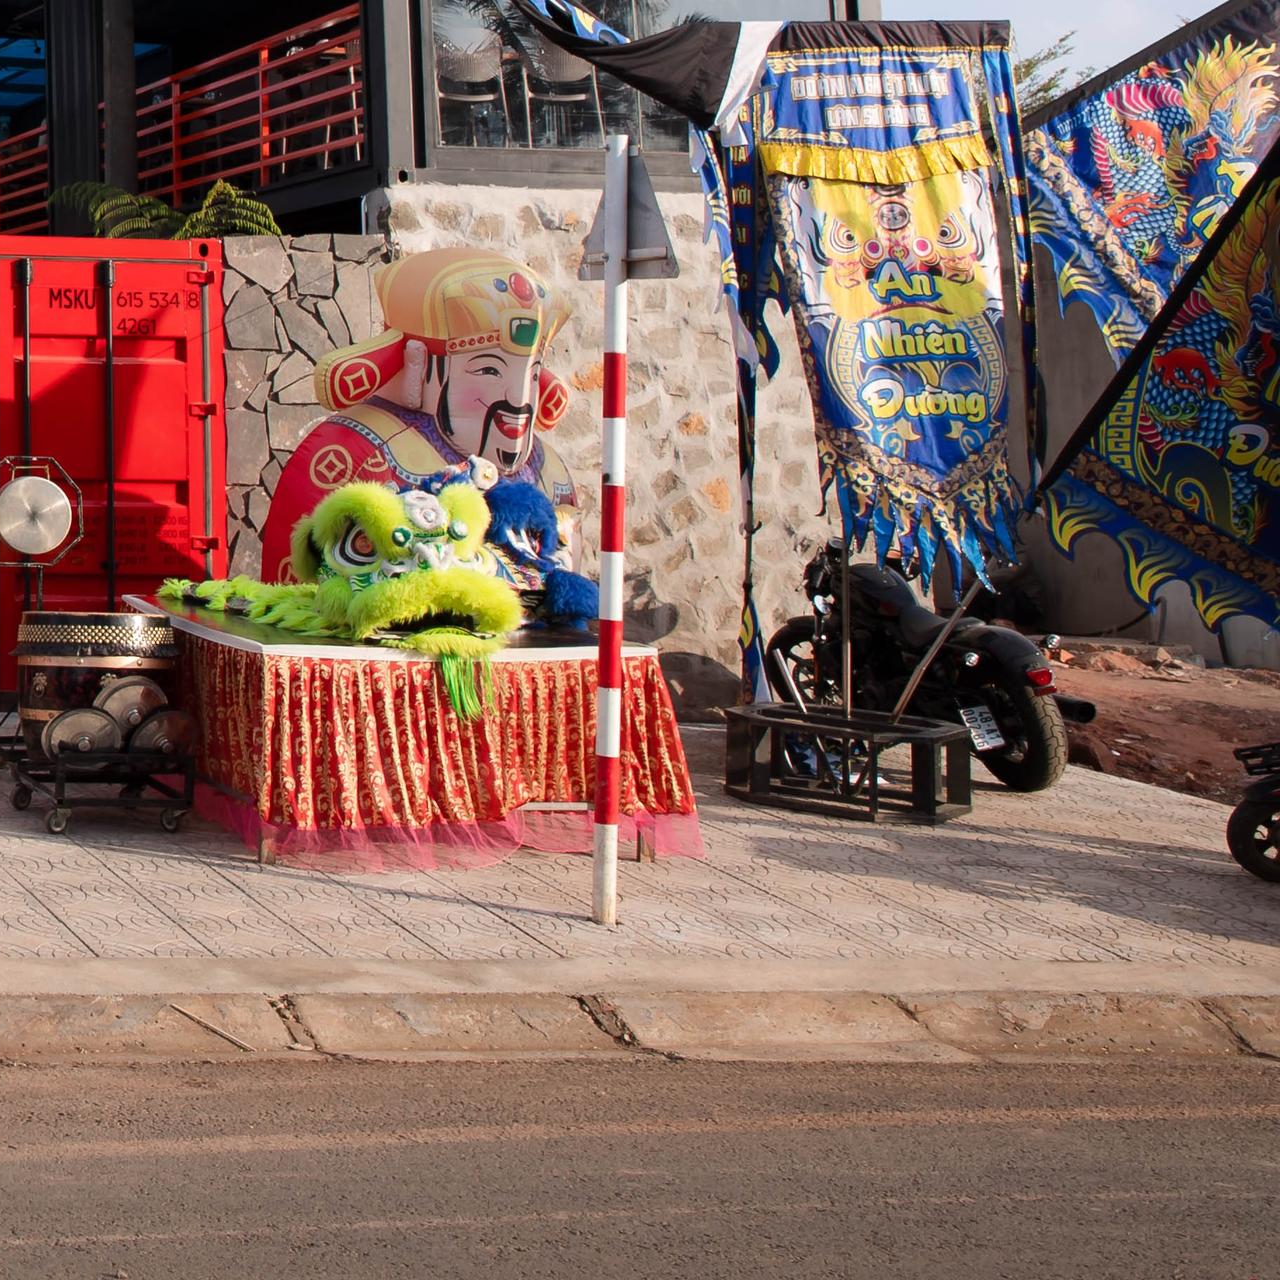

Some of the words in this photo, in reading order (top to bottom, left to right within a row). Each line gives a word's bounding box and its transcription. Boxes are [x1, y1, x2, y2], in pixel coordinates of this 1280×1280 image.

[873, 259, 933, 298] An
[49, 288, 96, 310] MSKU
[116, 291, 143, 309] 615
[149, 292, 180, 309] 534
[188, 292, 199, 309] 8
[116, 318, 157, 335] 42G1
[862, 320, 968, 359] Nhiên
[861, 379, 987, 423] Đường
